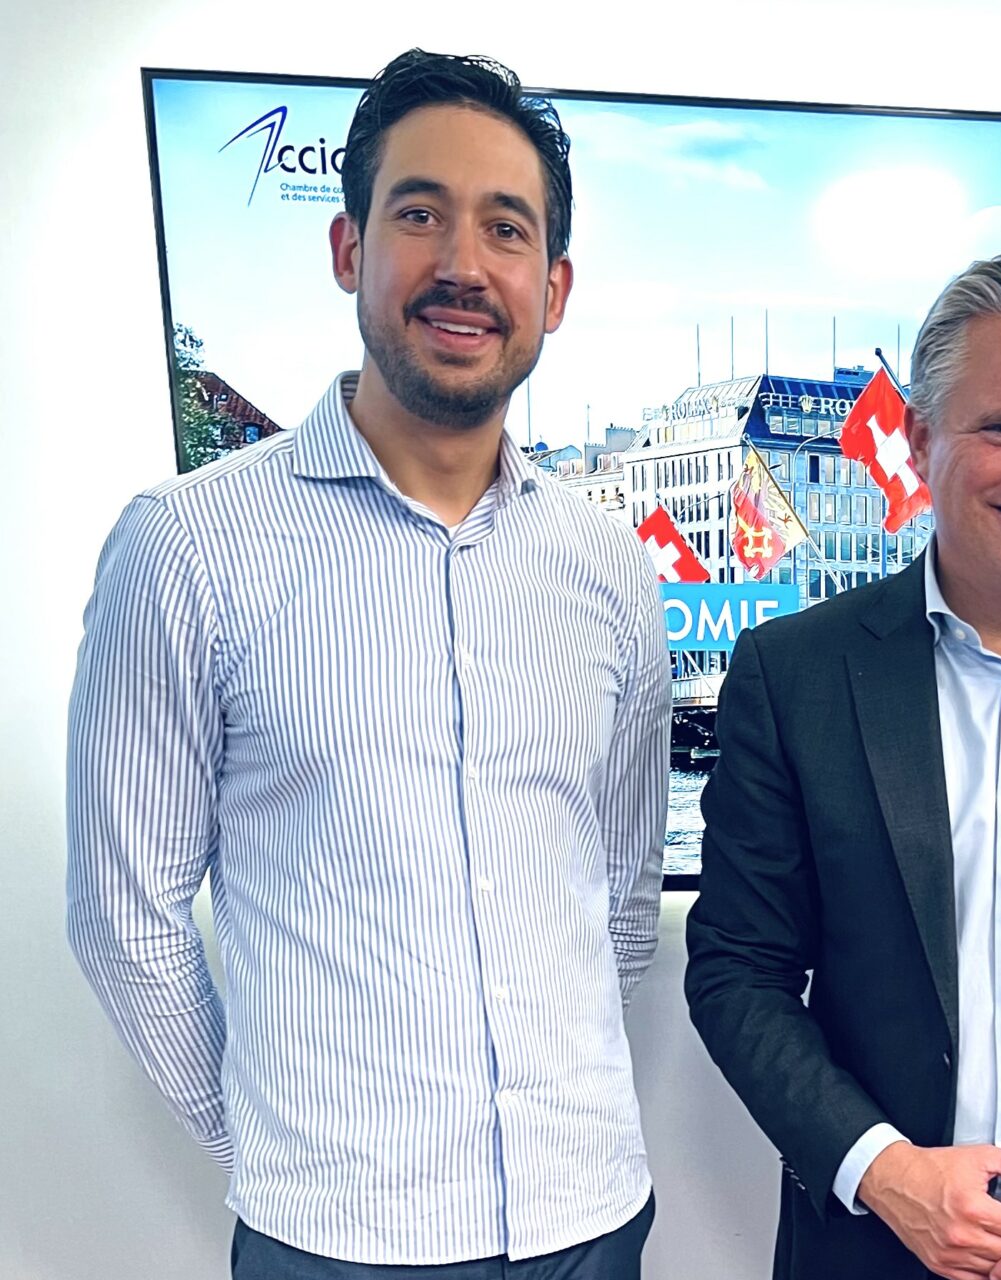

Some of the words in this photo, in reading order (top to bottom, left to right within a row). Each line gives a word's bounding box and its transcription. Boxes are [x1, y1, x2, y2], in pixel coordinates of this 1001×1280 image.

[280, 182, 318, 193] Chambre
[319, 184, 331, 193] de
[281, 193, 290, 201] et
[291, 193, 306, 202] des
[307, 194, 340, 203] services
